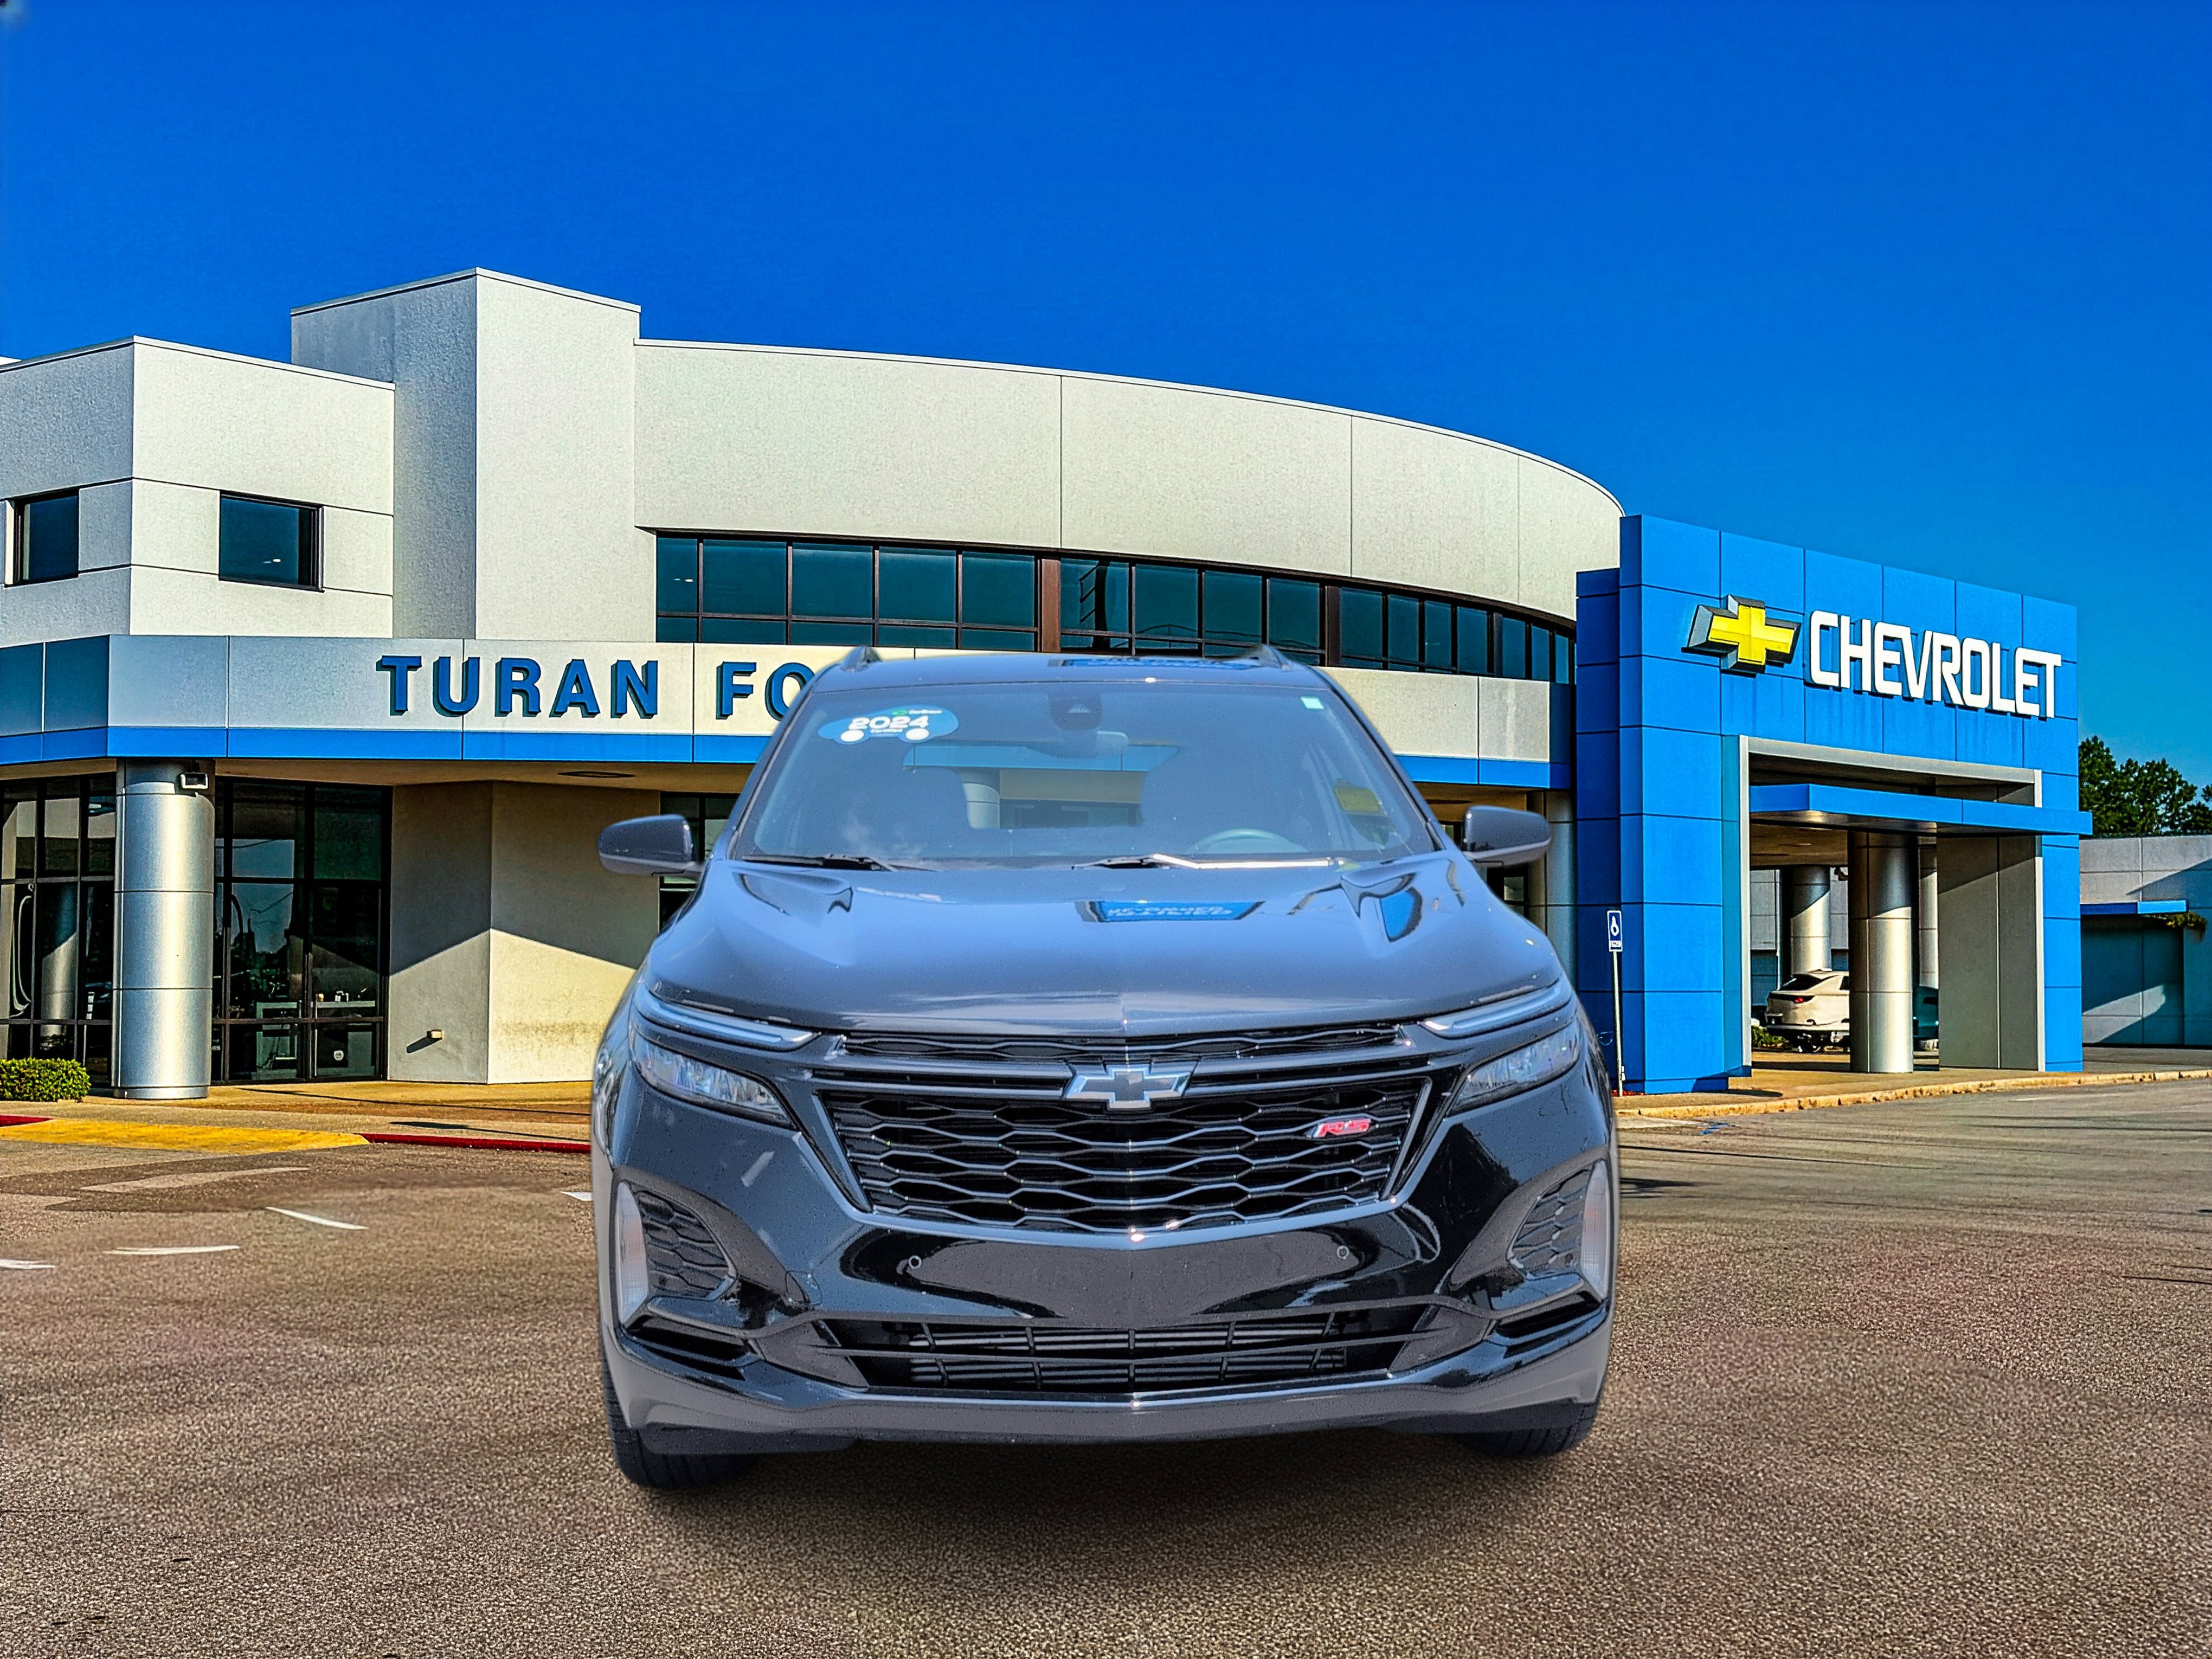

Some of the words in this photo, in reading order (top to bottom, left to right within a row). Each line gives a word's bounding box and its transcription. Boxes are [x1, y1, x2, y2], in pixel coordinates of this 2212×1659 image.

[1809, 610, 2062, 719] CHEVROLET
[376, 655, 659, 719] TURAN
[848, 716, 929, 730] 2024
[1313, 1118, 1372, 1138] RS
